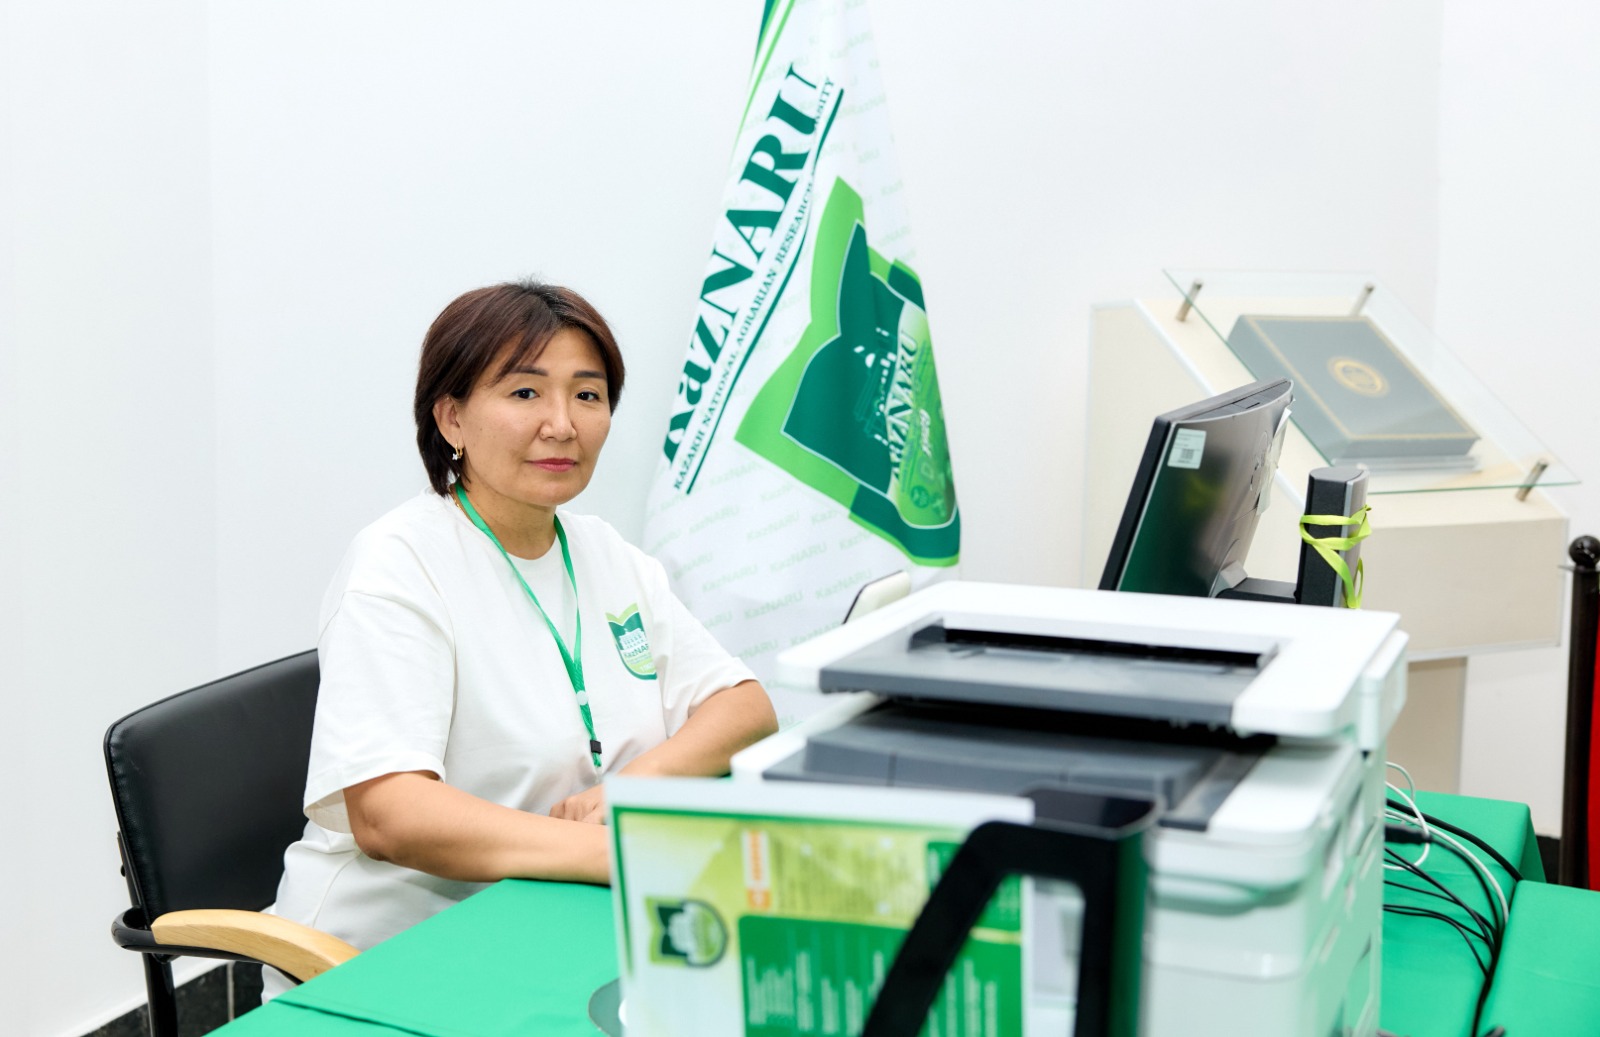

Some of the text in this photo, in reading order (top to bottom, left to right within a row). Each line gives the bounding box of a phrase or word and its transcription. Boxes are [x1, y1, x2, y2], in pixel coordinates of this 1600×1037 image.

[673, 429, 705, 491] KAZAKH
[702, 349, 739, 427] NATIONAL
[737, 268, 779, 348] AGRARIAN
